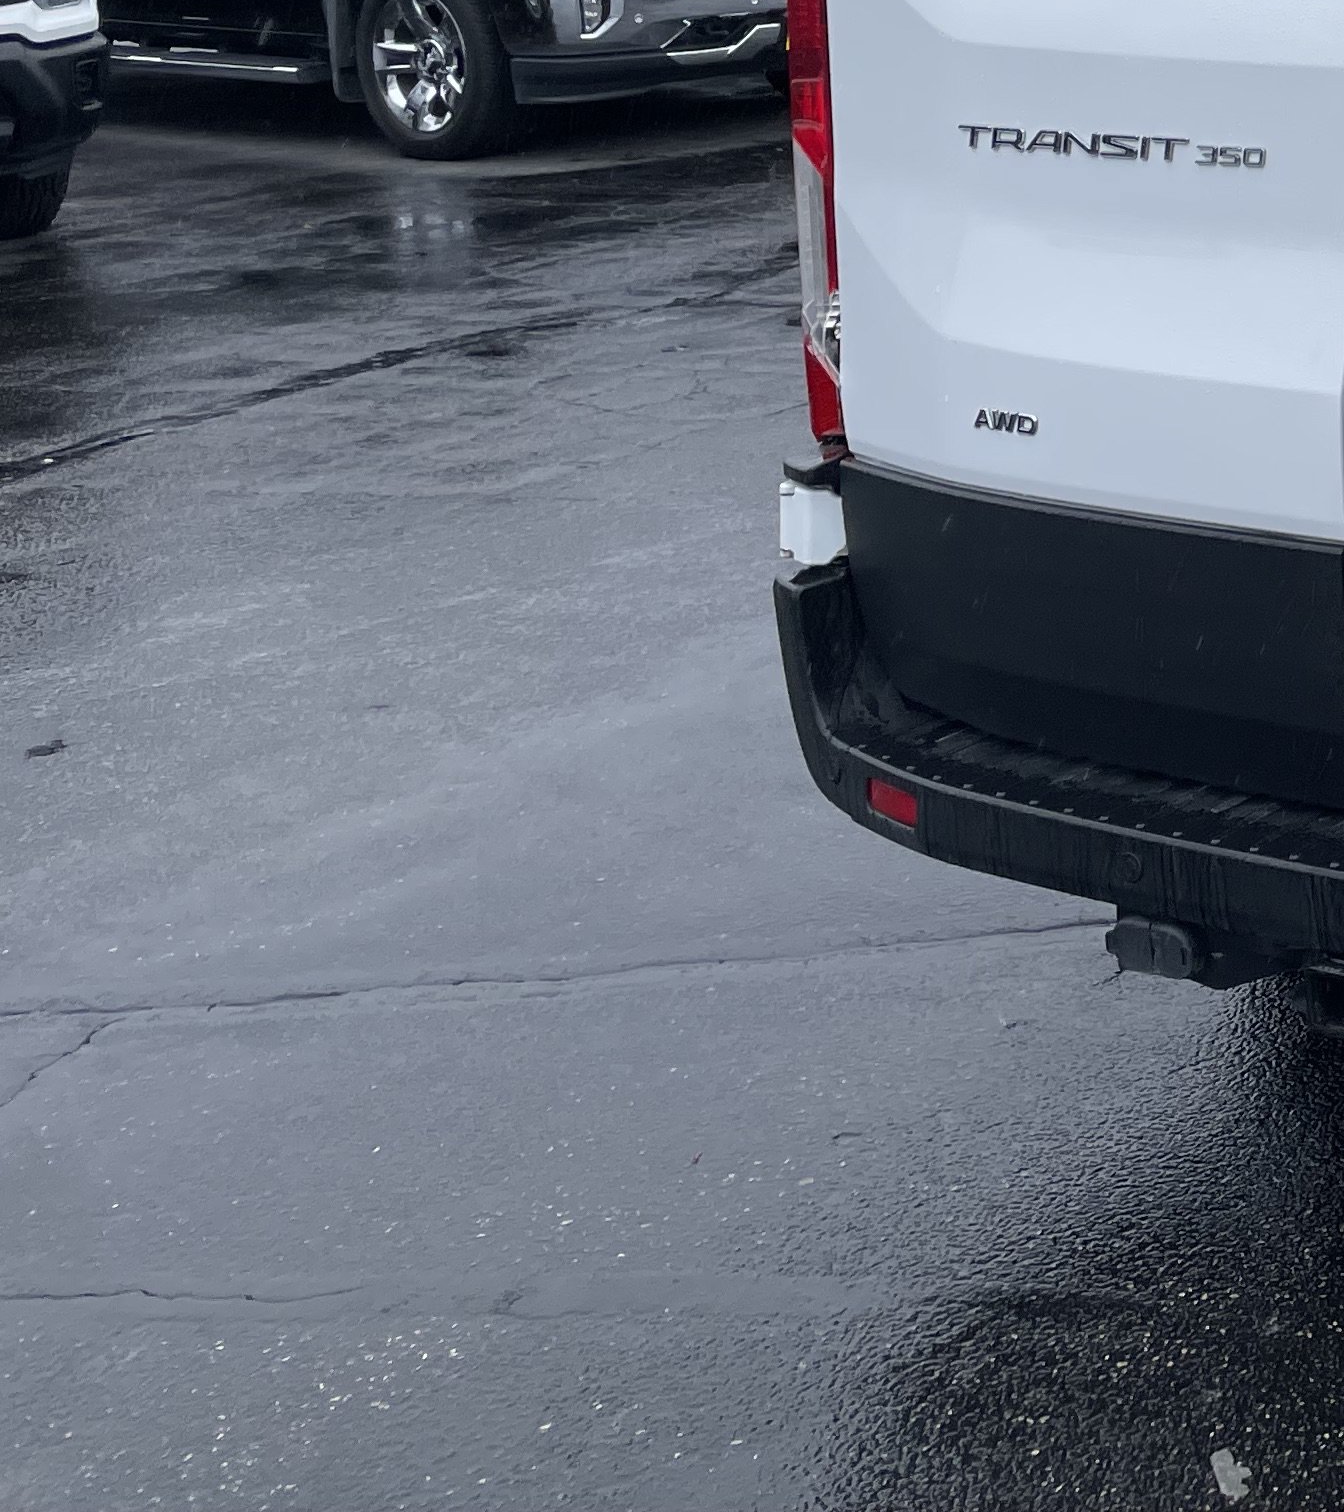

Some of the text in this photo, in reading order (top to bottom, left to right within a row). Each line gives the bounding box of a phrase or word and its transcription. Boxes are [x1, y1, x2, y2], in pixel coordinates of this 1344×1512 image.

[958, 124, 1267, 169] TRANSIT 350
[974, 407, 1039, 437] AWD
